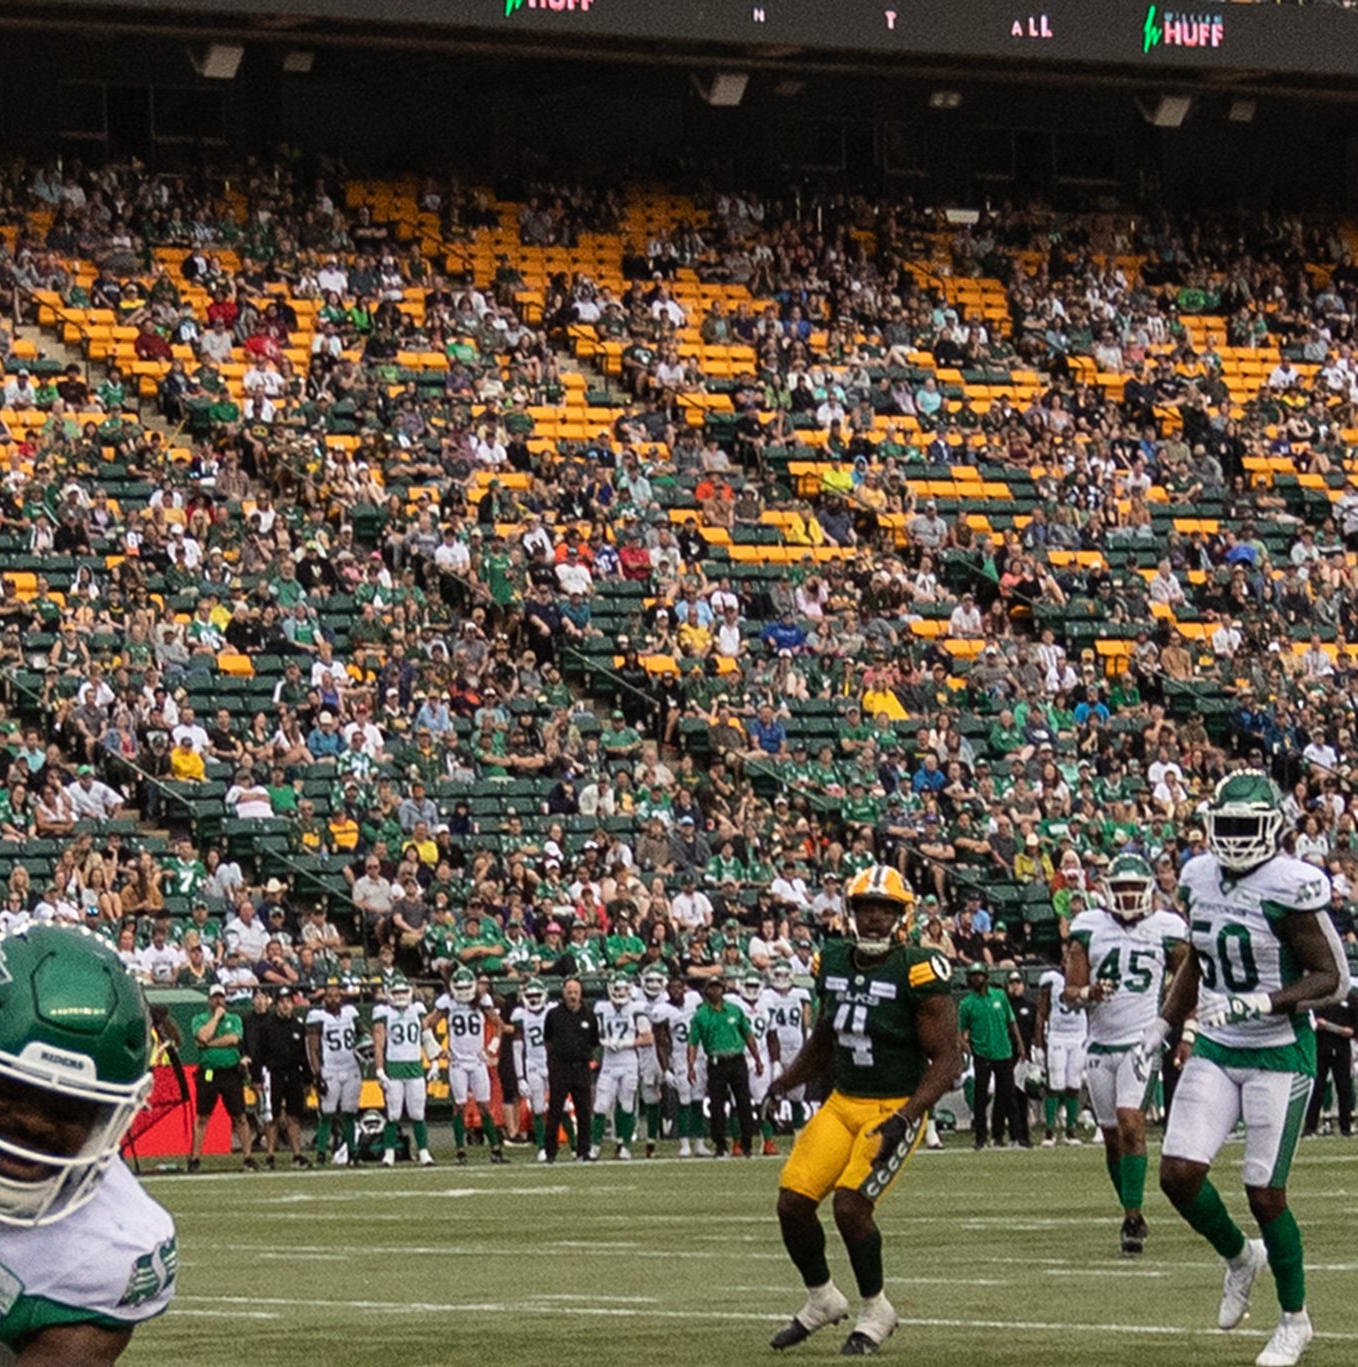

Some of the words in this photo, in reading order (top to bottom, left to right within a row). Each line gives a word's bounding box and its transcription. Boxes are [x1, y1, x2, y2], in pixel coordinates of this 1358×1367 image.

[1164, 21, 1223, 47] HUFF
[1096, 947, 1156, 993] 45
[389, 1022, 419, 1045] 30
[833, 1003, 875, 1067] 4
